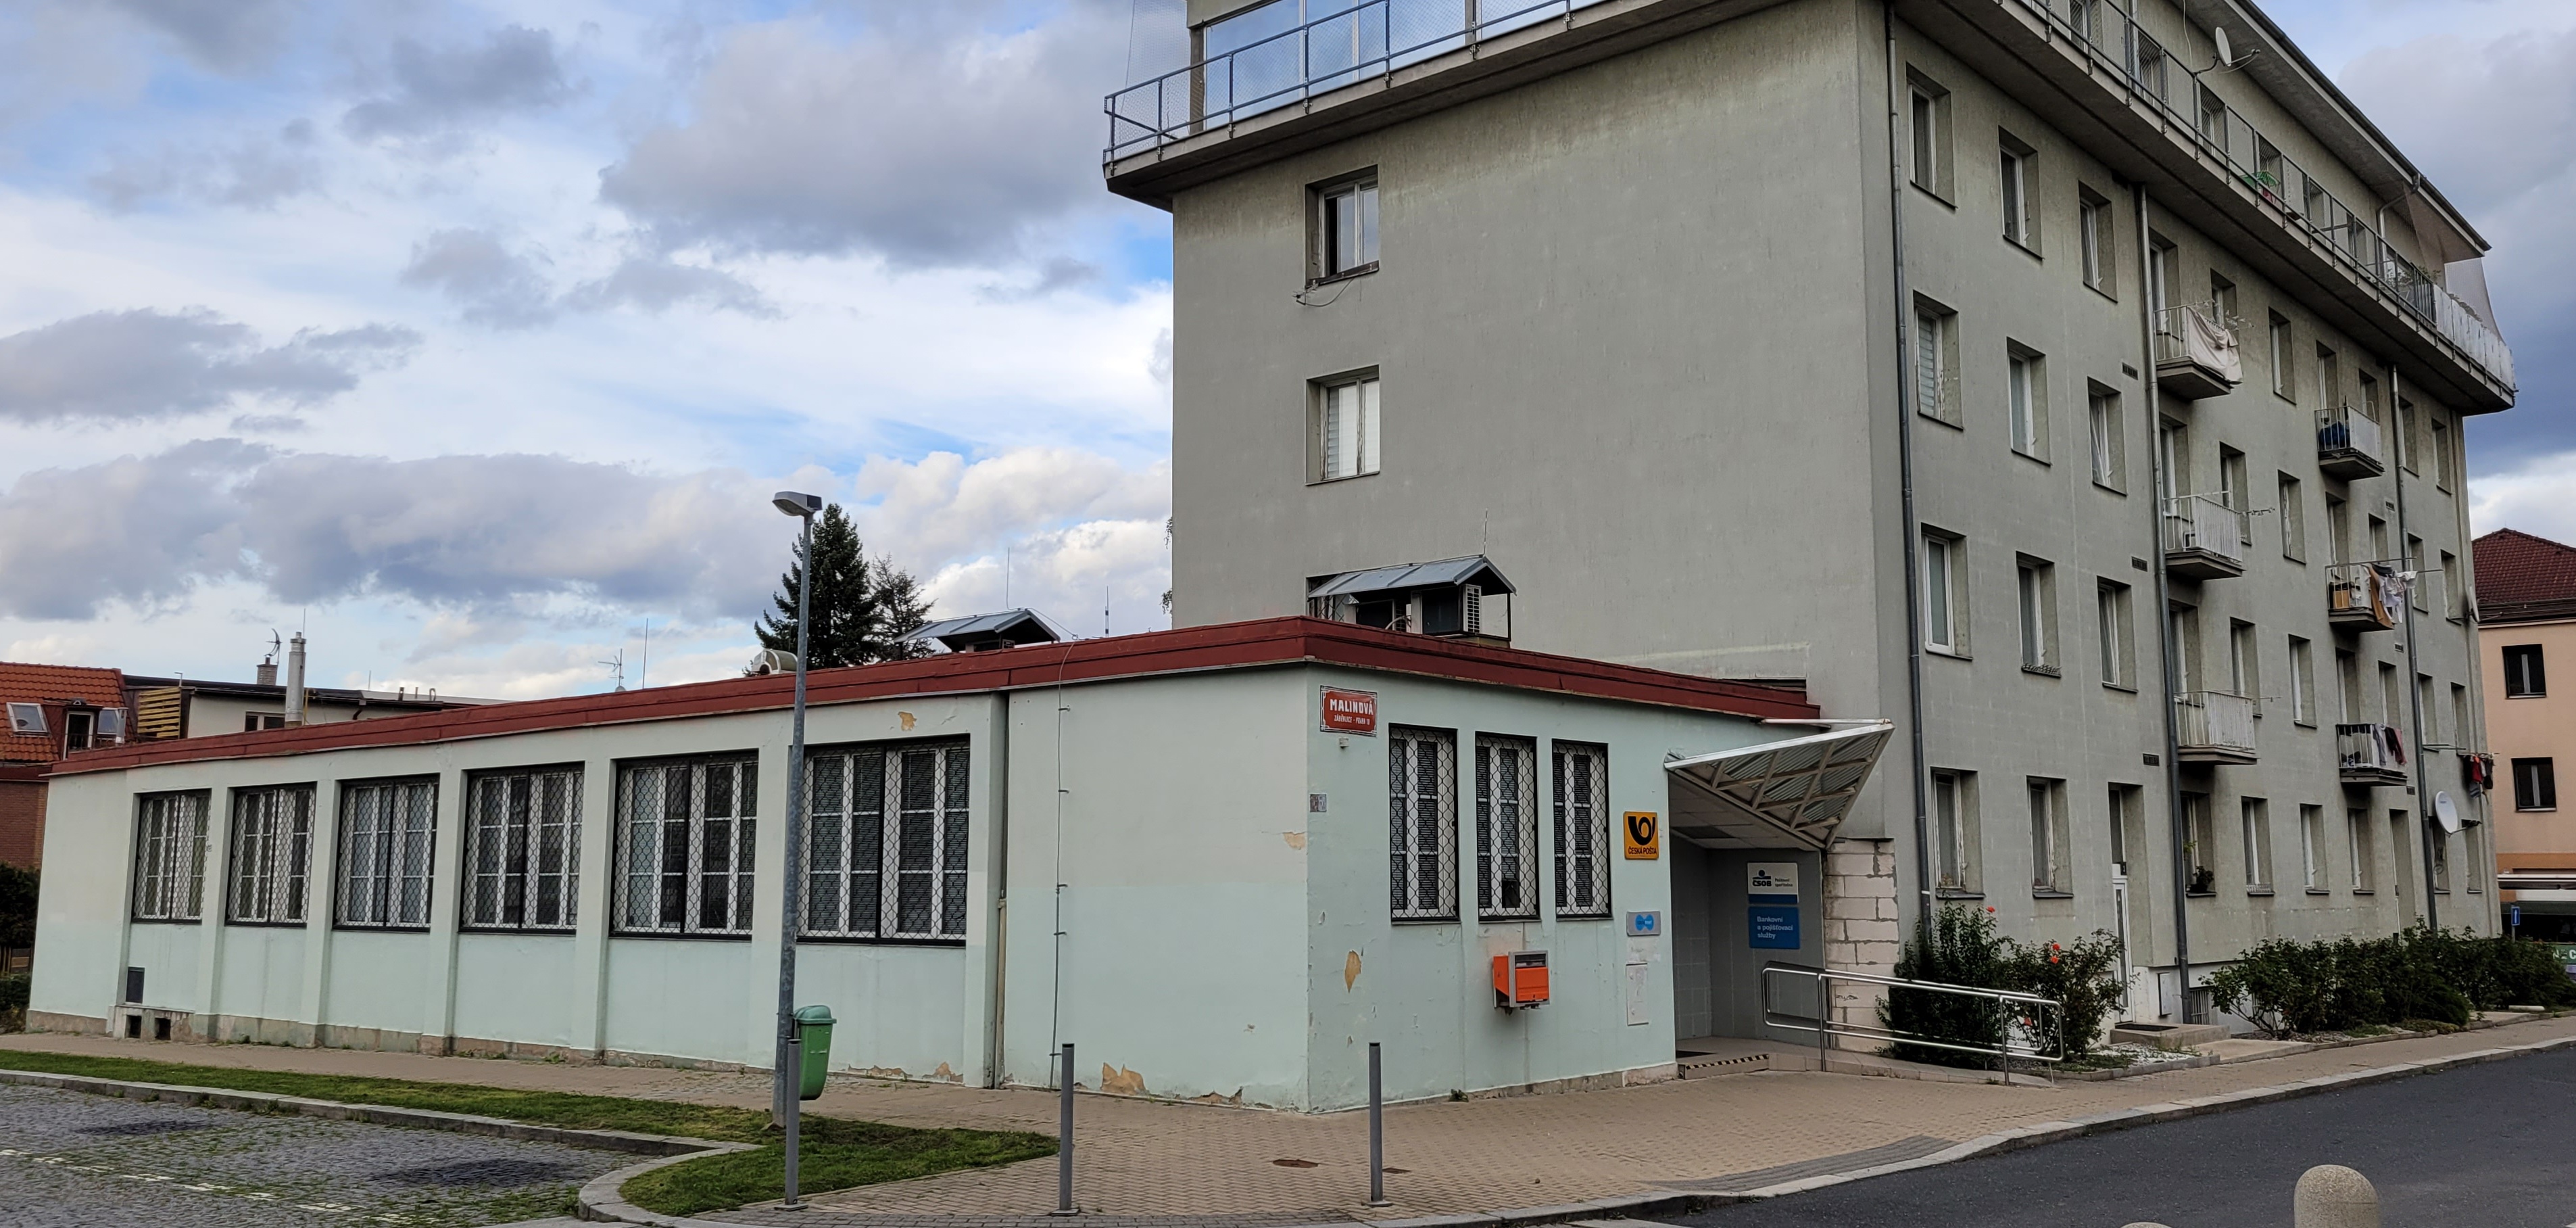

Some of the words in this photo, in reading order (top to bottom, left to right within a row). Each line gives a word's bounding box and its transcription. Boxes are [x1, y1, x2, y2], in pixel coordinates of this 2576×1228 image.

[1330, 699, 1374, 715] MALINOVÁ
[1628, 846, 1643, 855] ČESKÁ
[1643, 847, 1657, 855] POŠTA
